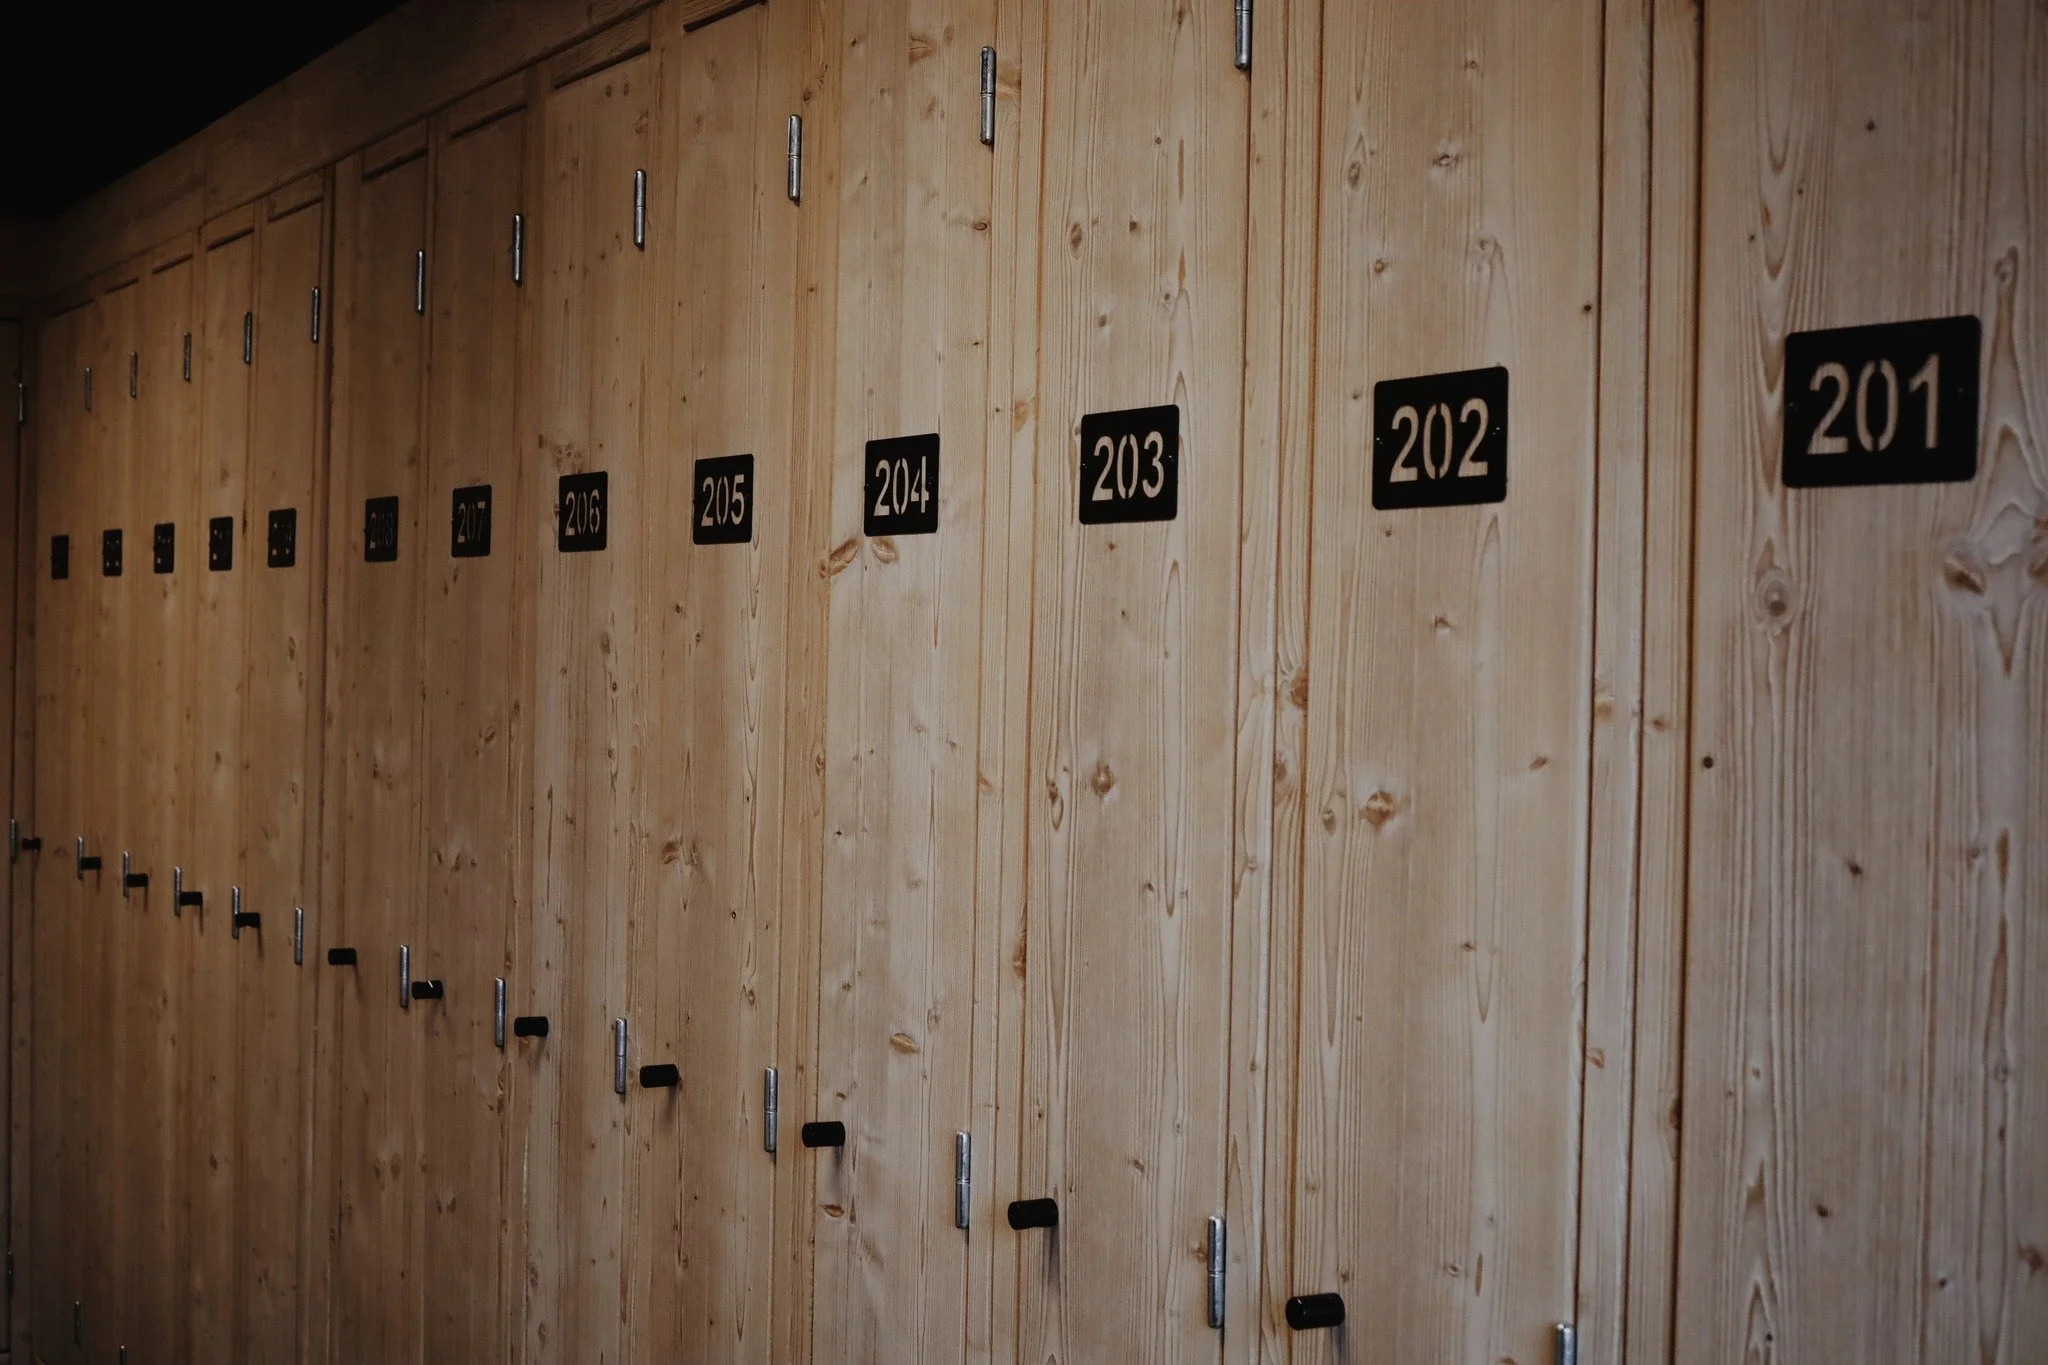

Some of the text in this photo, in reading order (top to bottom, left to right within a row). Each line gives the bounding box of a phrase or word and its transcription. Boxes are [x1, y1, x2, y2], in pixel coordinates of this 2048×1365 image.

[1807, 354, 1939, 456] 201
[1091, 430, 1166, 502] 203
[1389, 398, 1490, 483] 202
[564, 489, 602, 537] 206
[700, 473, 746, 527] 205
[873, 455, 931, 517] 204
[457, 499, 486, 544] 207
